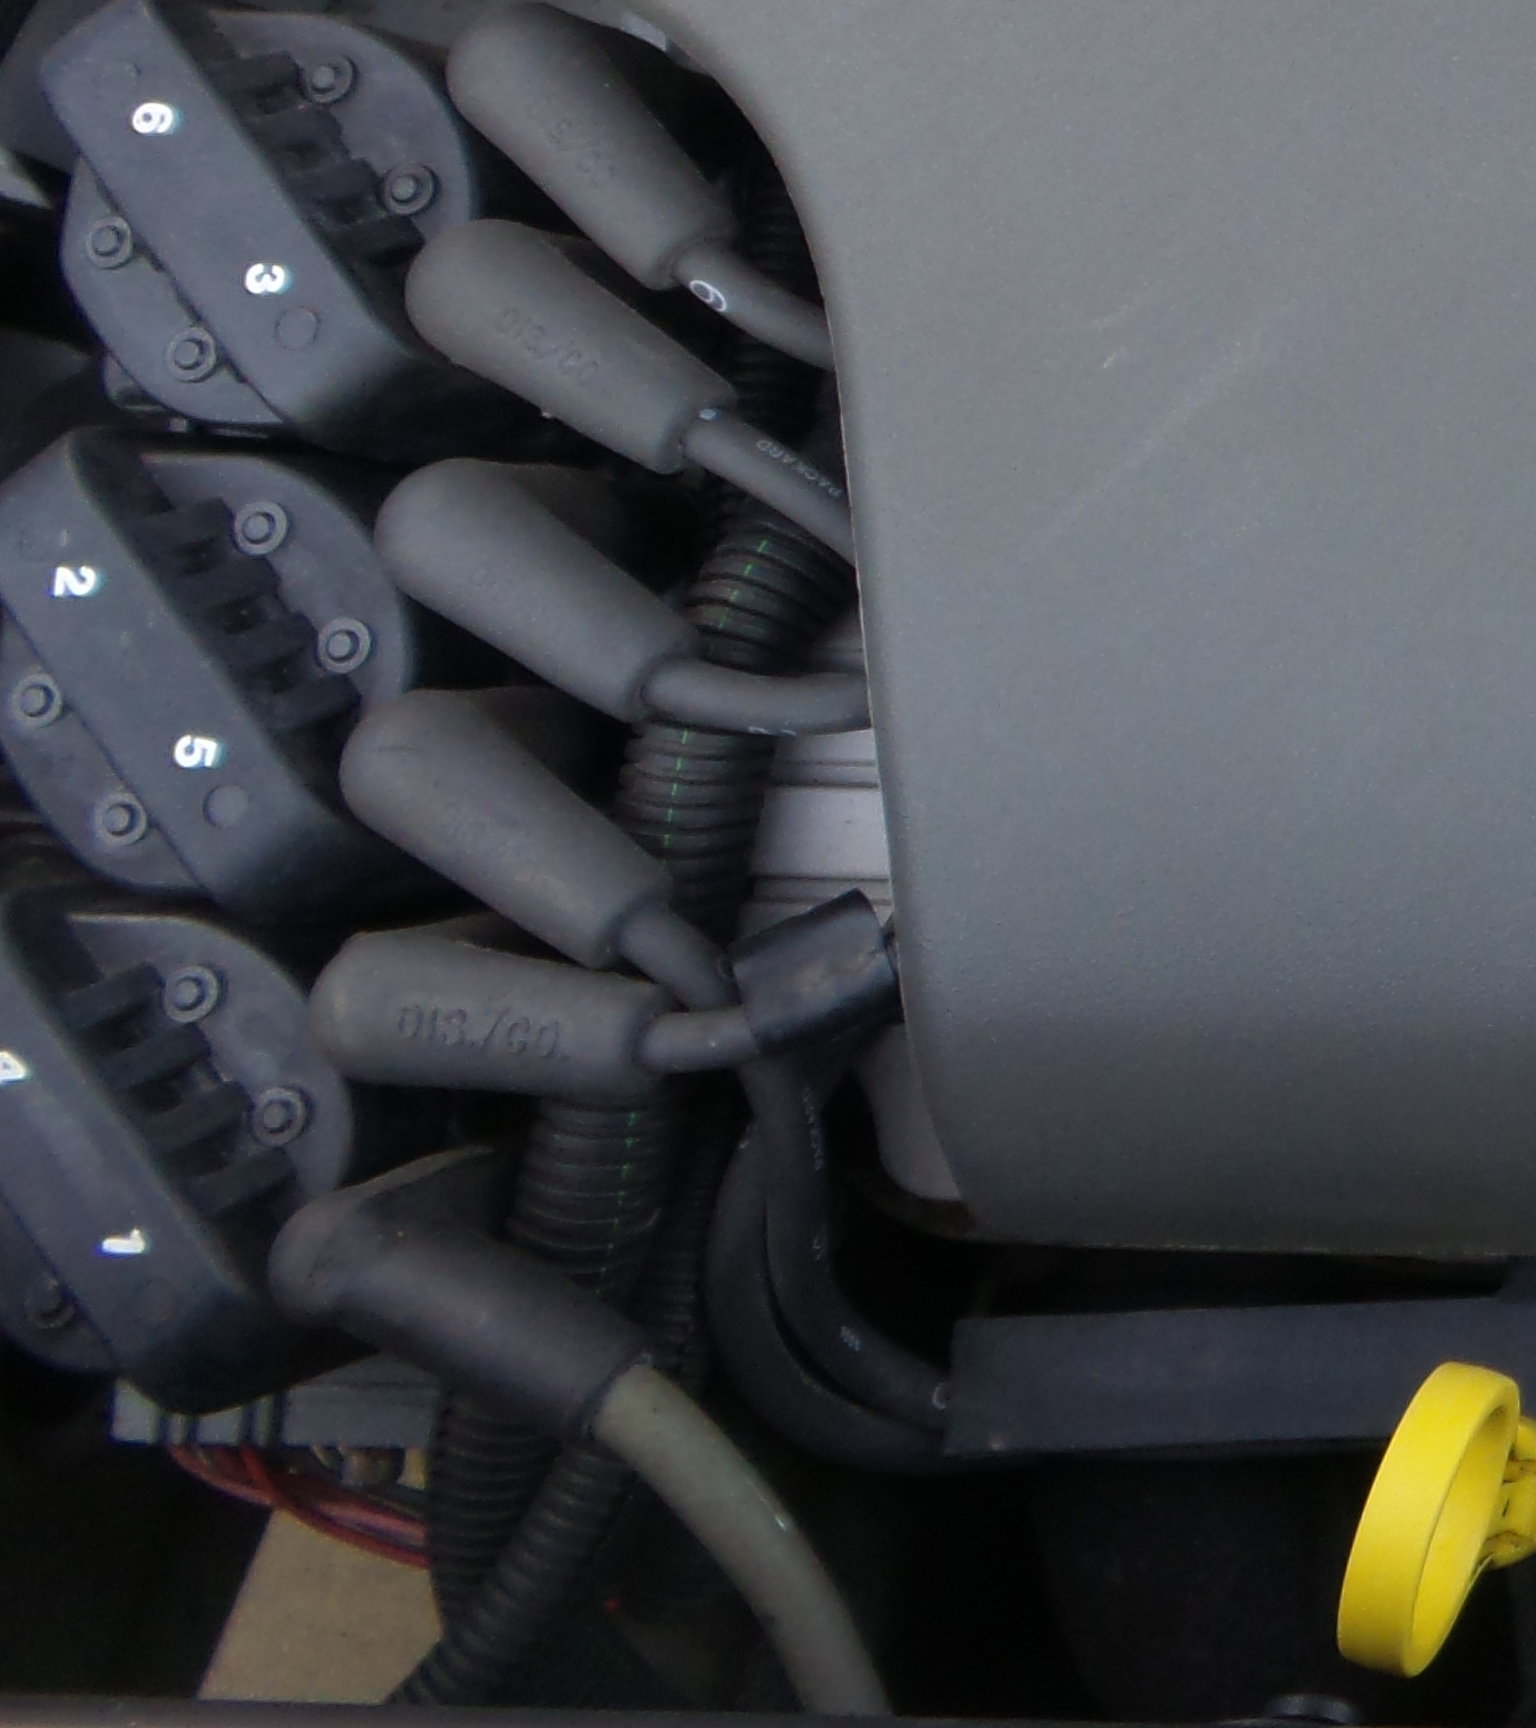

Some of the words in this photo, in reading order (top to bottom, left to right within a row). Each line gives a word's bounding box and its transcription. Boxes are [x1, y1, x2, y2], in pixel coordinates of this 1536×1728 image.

[245, 263, 286, 295] 3
[53, 565, 96, 597] 2
[174, 735, 218, 768] 5
[101, 1228, 147, 1254] 1
